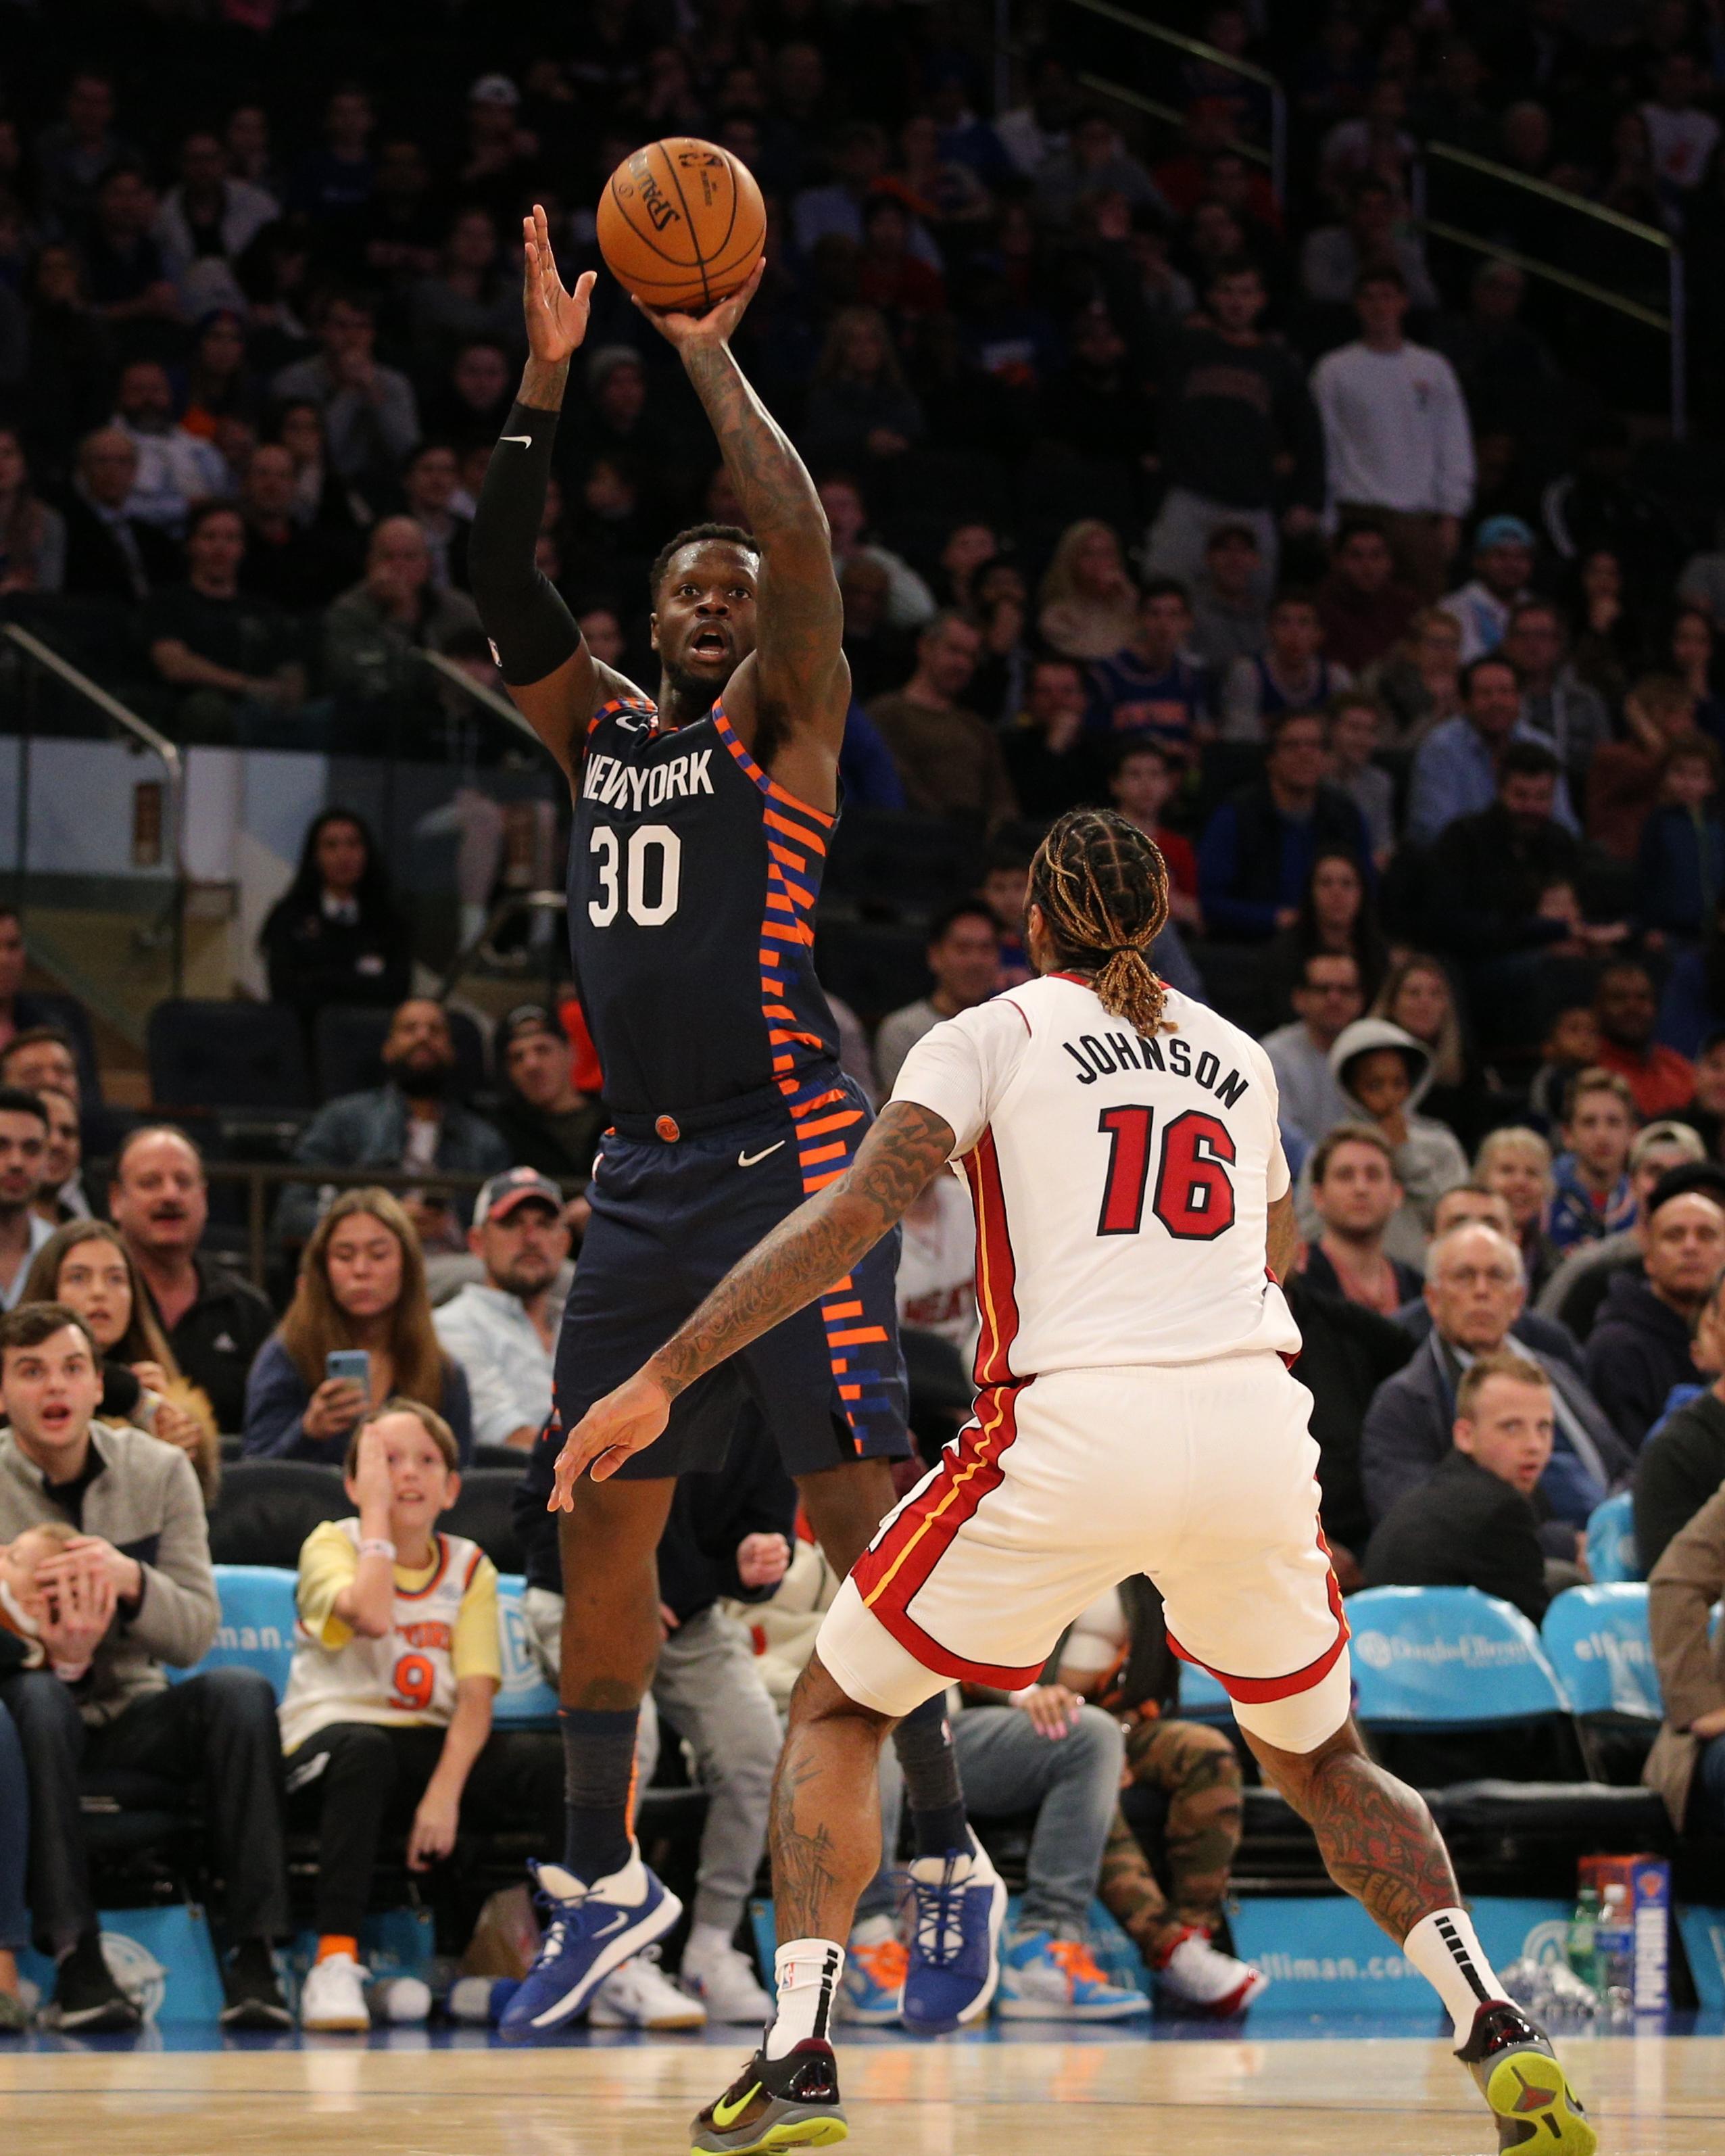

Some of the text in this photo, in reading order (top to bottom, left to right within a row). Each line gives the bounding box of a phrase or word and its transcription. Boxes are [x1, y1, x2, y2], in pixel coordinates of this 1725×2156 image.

[583, 748, 714, 812] NEW YORK
[587, 824, 681, 928] 30
[1062, 1032, 1250, 1110] JOHNSON
[1096, 1103, 1237, 1241] 16
[387, 1654, 435, 1710] 9
